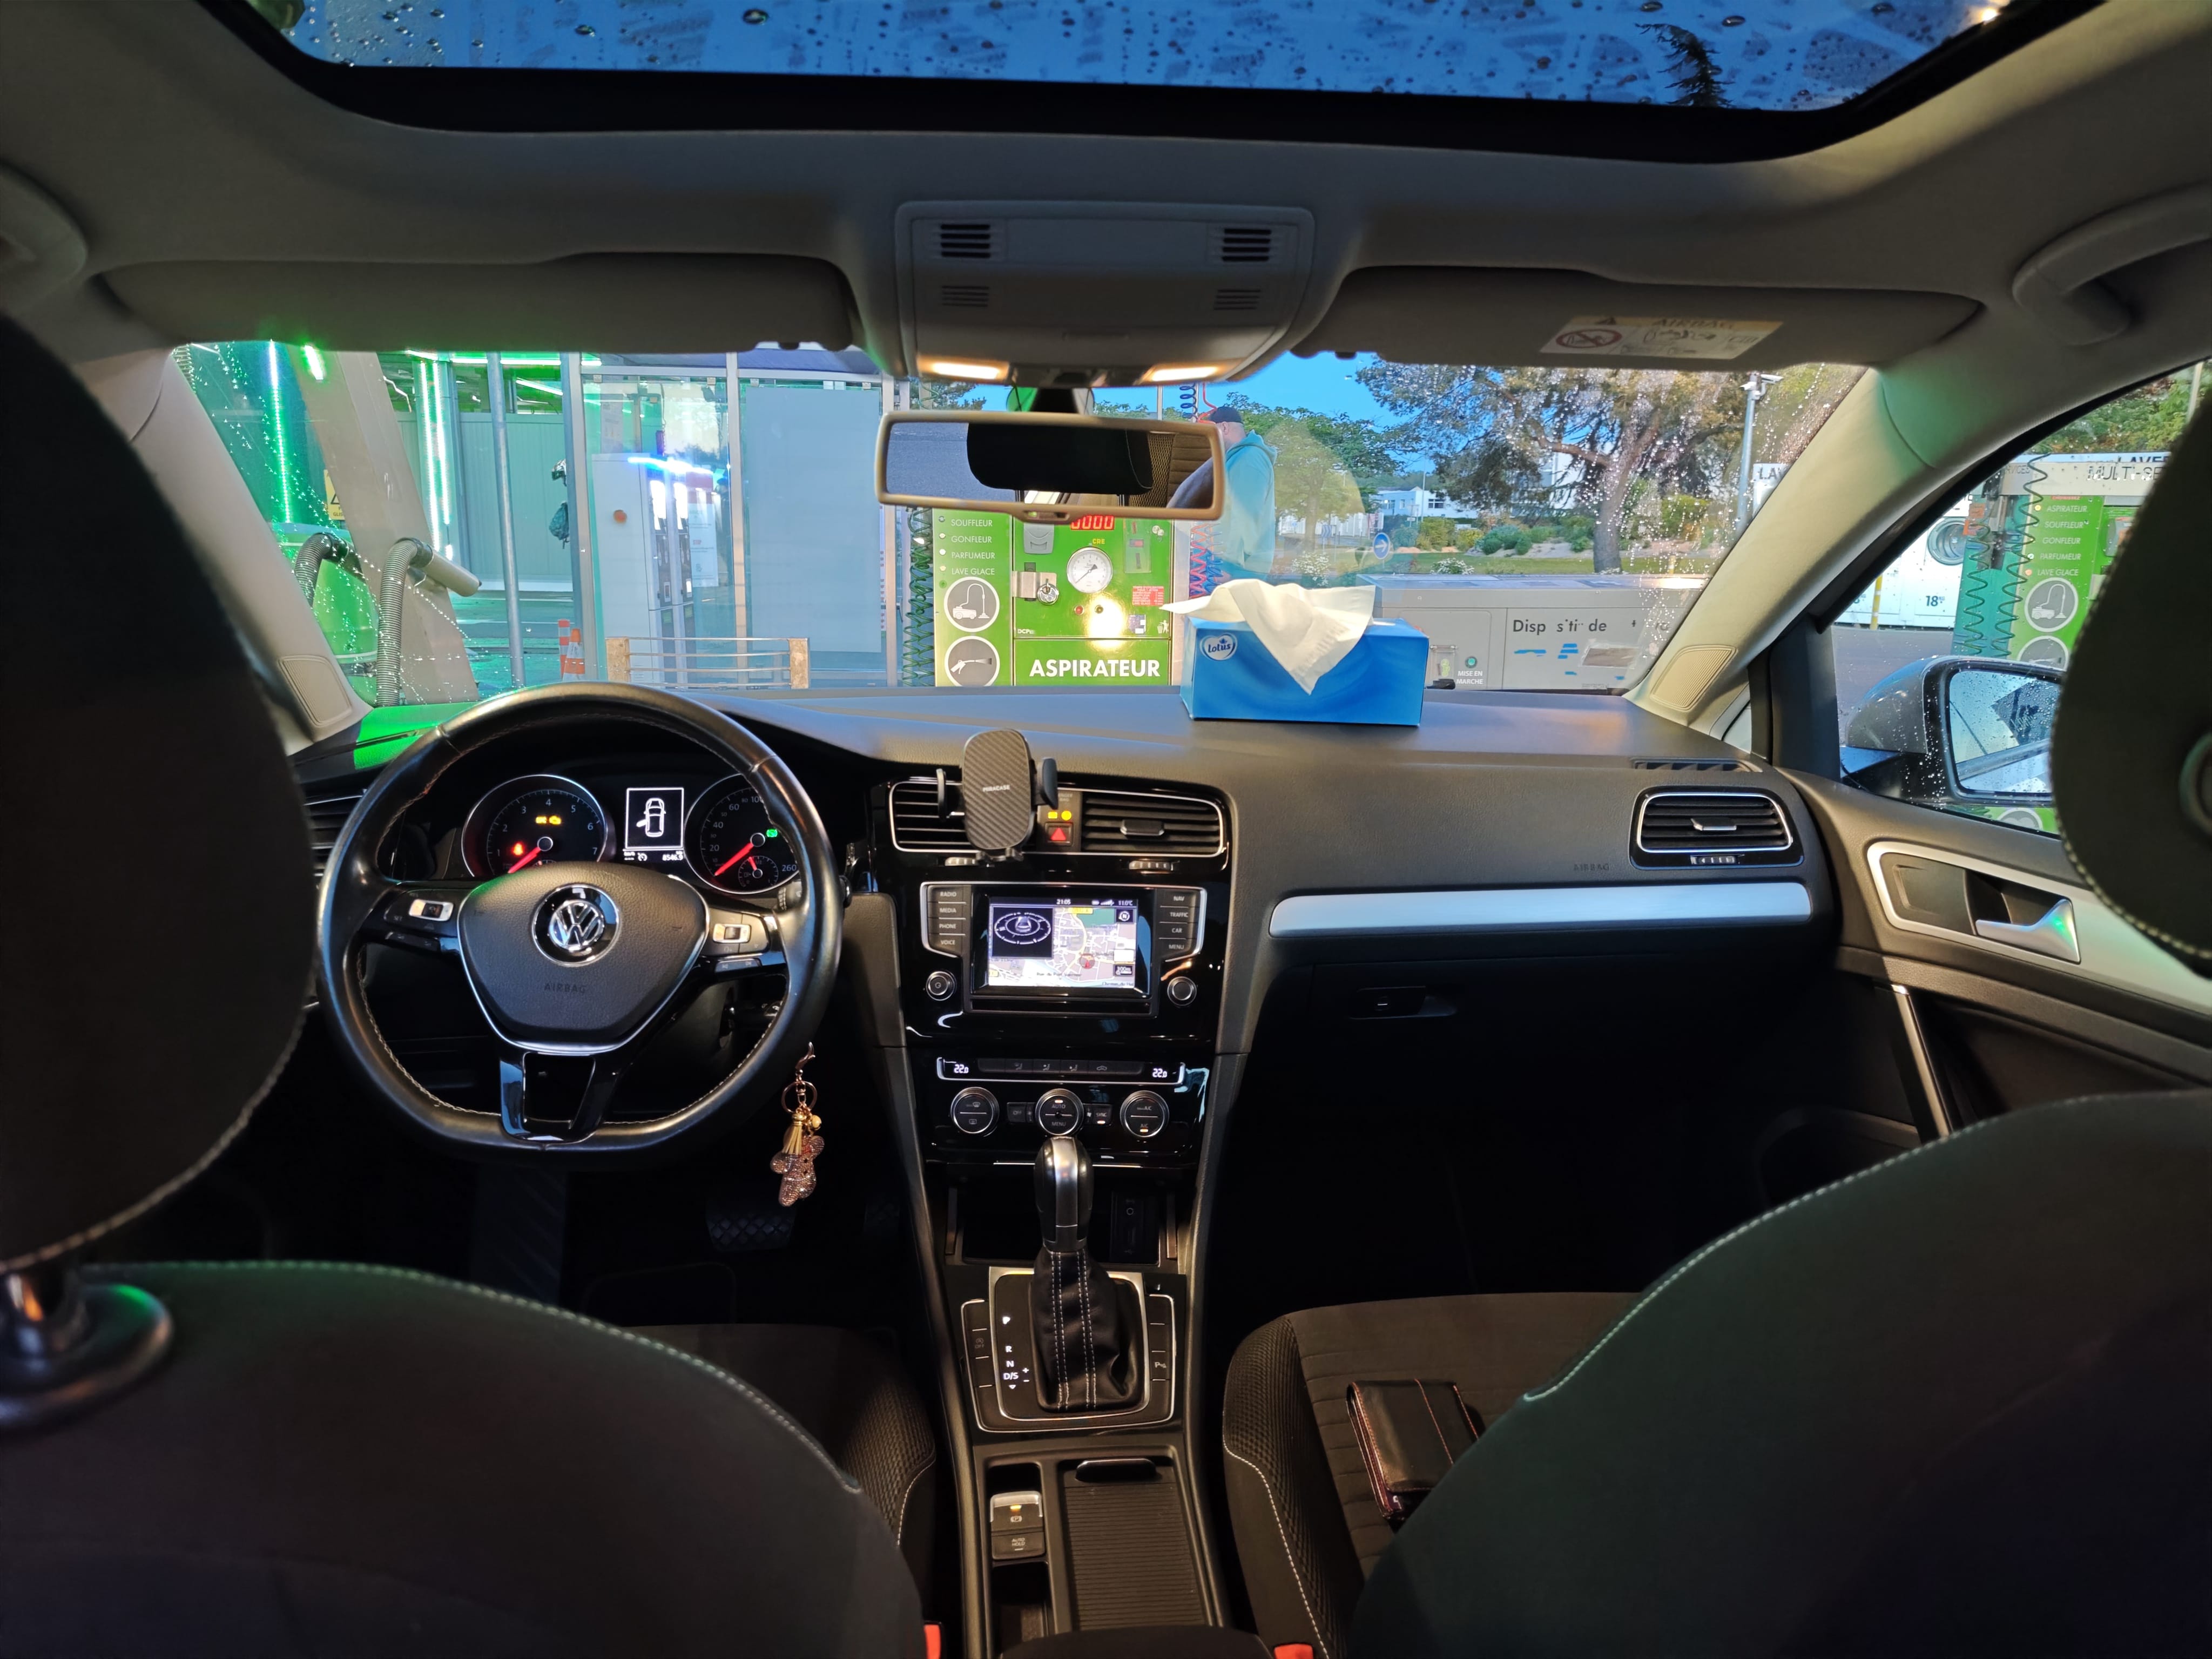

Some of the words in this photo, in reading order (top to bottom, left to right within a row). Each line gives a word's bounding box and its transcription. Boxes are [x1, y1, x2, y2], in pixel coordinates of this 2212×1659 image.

[2088, 466, 2163, 481] MULTI-SE
[951, 519, 993, 527] SOUFFLEUR
[1588, 618, 1607, 632] de
[1029, 659, 1161, 677] ASPIRATEUR
[588, 822, 593, 831] 6
[544, 983, 586, 993] AIRBAG
[1002, 1316, 1011, 1324] P
[1003, 1372, 1019, 1380] D/S
